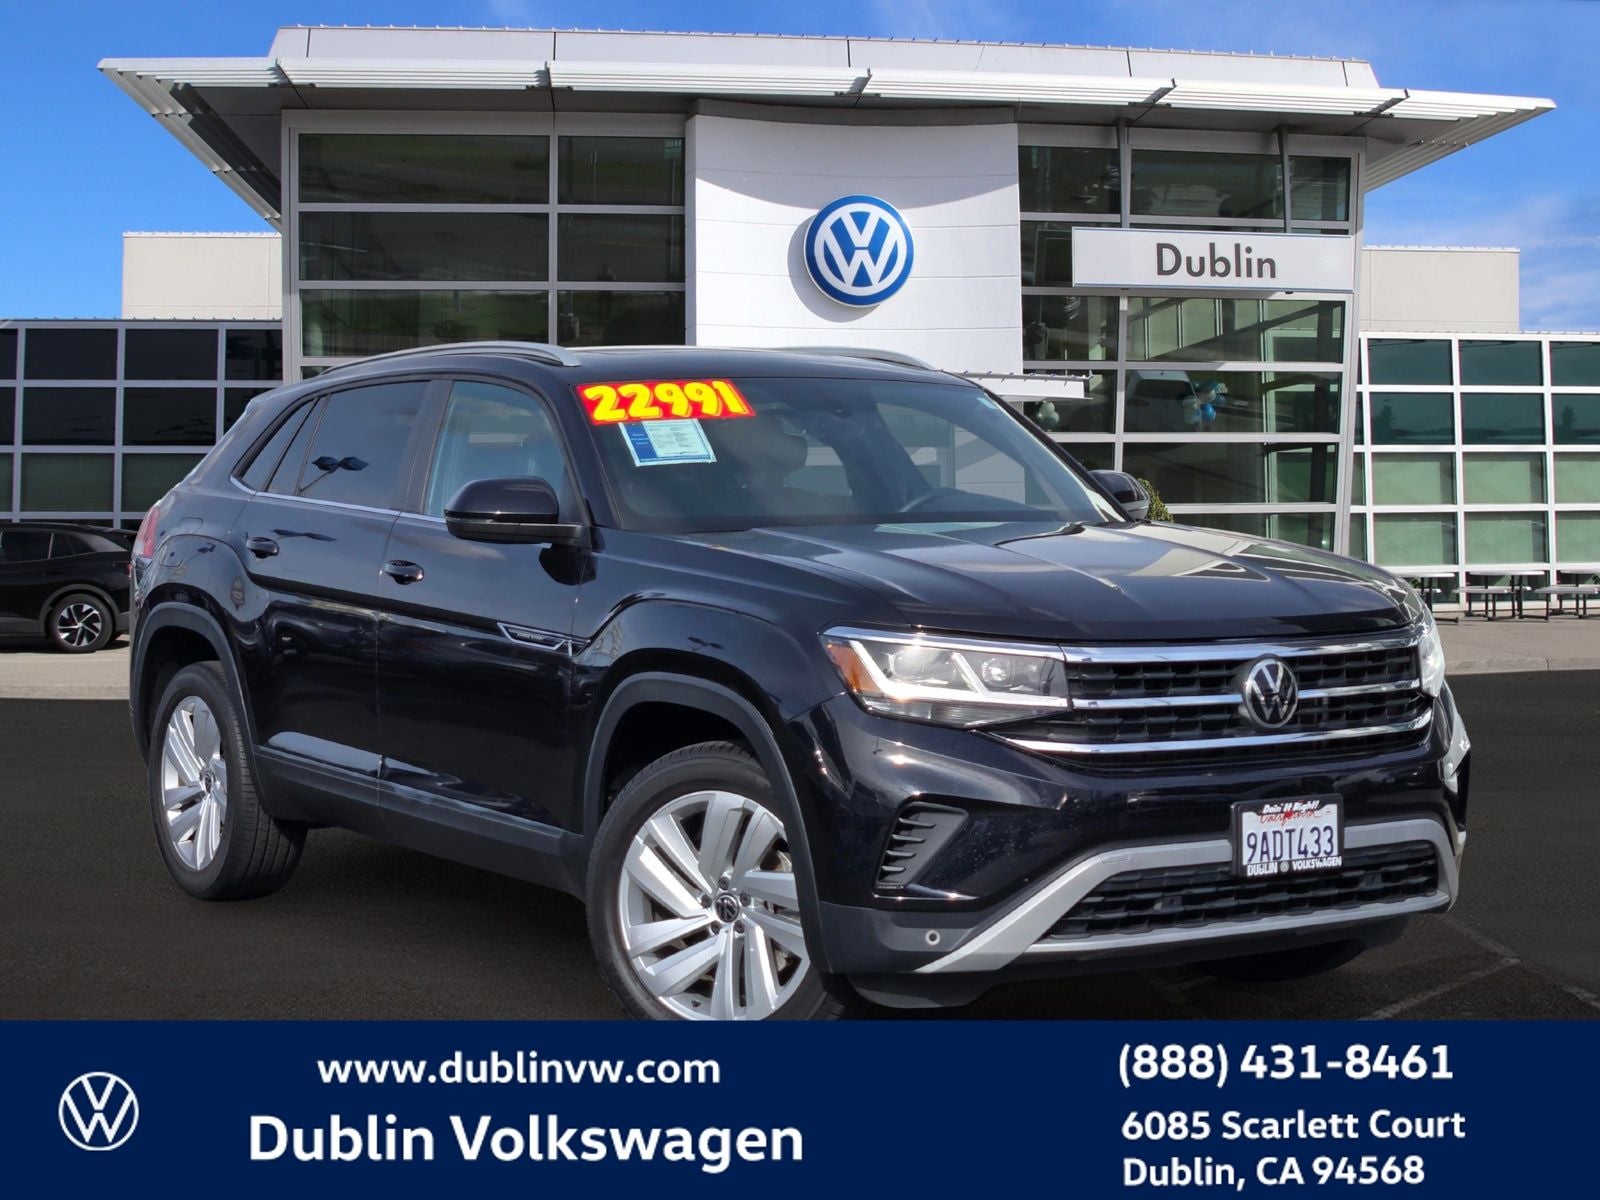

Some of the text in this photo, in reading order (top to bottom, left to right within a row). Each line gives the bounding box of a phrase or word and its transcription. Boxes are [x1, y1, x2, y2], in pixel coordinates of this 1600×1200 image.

[812, 201, 908, 298] VW
[1156, 242, 1276, 279] Dublin
[583, 380, 750, 422] 22991
[1247, 657, 1297, 727] VW
[1246, 825, 1334, 863] 9ADT433
[1247, 862, 1278, 877] DUBLIN
[1292, 856, 1342, 871] VOLKSWAGEN
